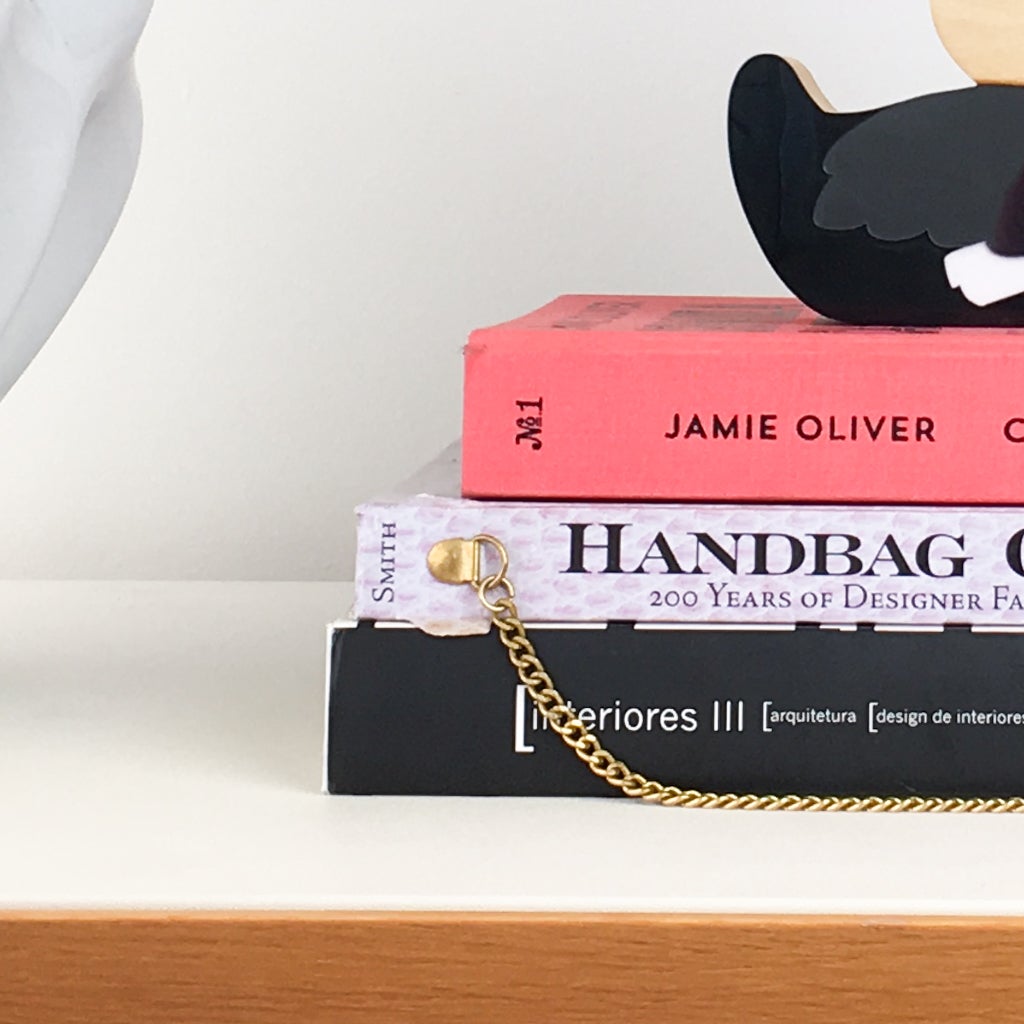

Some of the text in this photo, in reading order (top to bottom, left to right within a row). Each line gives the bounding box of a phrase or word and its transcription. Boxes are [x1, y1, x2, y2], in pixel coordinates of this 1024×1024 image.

[665, 414, 935, 442] JAMIE OLIVER
[372, 523, 396, 603] SMITH
[558, 523, 974, 578] HANDBAG
[650, 590, 698, 608] 200
[707, 582, 791, 608] YEARS
[801, 593, 832, 608] OF
[843, 584, 982, 610] DESIGNER
[932, 709, 952, 724] de
